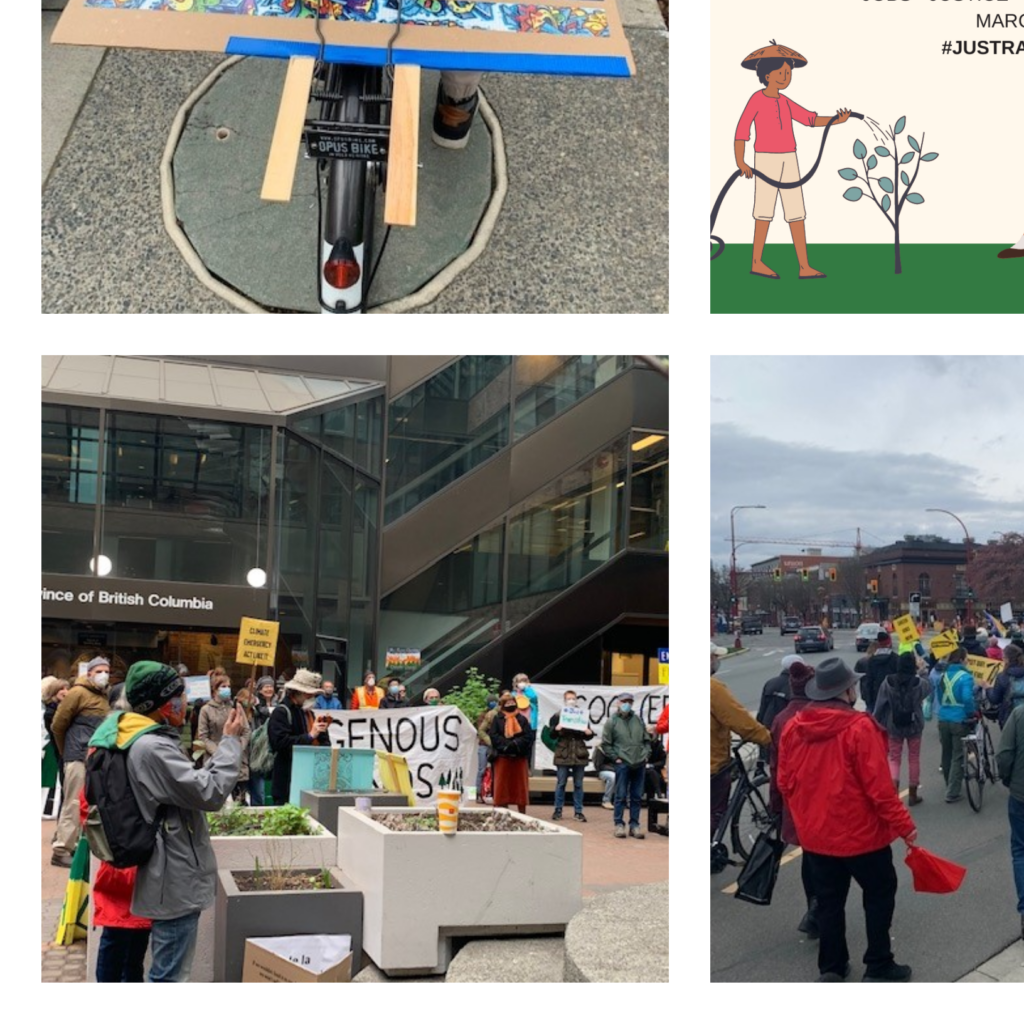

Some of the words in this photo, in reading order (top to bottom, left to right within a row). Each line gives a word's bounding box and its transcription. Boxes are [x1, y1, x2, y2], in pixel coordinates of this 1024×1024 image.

[318, 140, 348, 153] OPUS
[351, 142, 379, 155] BIKE
[41, 587, 73, 602] ince
[78, 590, 95, 603] of
[98, 590, 144, 606] British
[148, 593, 213, 610] Columbia
